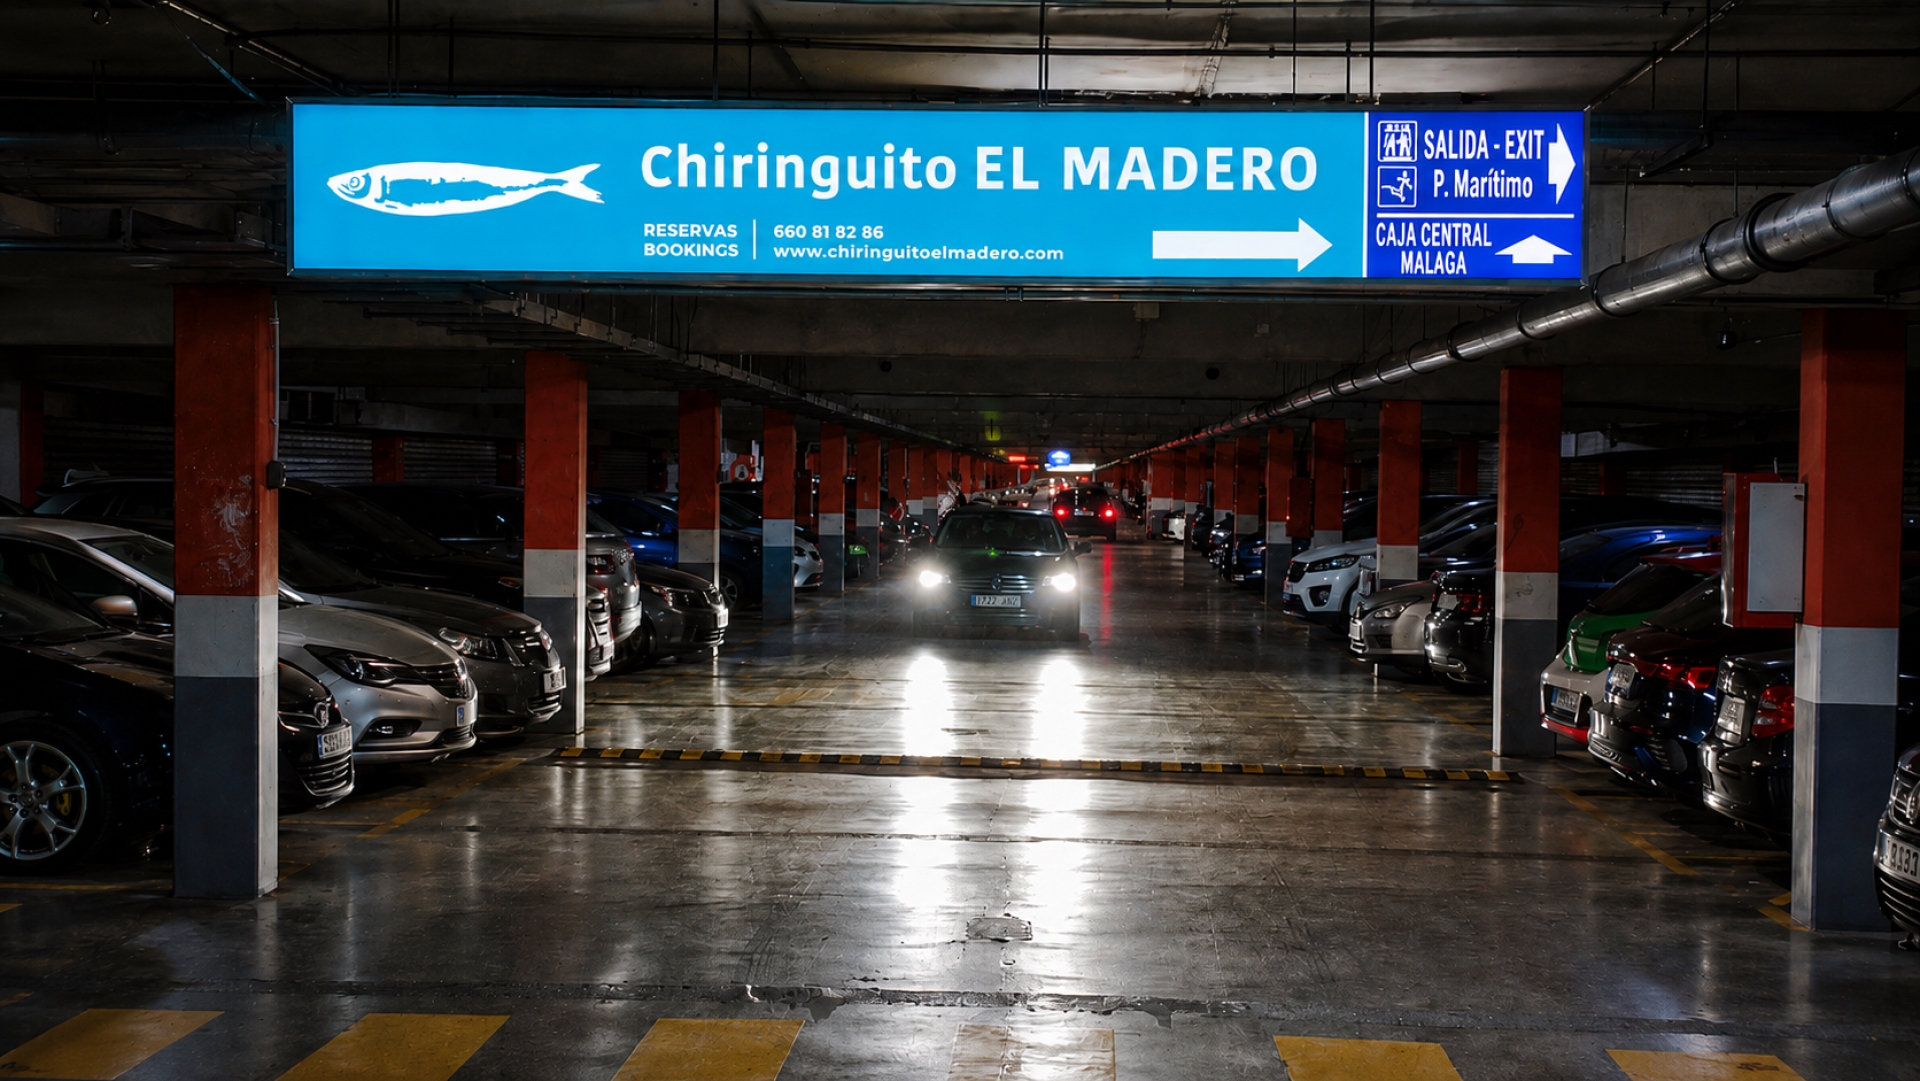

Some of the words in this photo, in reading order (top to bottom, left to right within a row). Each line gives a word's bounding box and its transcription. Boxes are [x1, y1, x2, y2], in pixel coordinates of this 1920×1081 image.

[1423, 129, 1489, 160] SALIDA
[1505, 129, 1545, 160] EXIT
[641, 142, 957, 200] Chiringuito
[976, 146, 1039, 190] EL
[1063, 146, 1318, 191] MADERO
[1433, 168, 1449, 198] P.
[1454, 167, 1533, 198] Marítimo
[643, 223, 738, 238] RESERVAS
[773, 225, 807, 239] 660
[811, 225, 830, 239] 81
[835, 225, 857, 239] 82
[861, 225, 884, 239] 86
[1376, 222, 1417, 247] CAJA
[1420, 222, 1493, 247] CENTRAL
[643, 243, 739, 257] BOOKINGS
[773, 244, 1064, 262] www.chiringuitoelmadero.com
[1400, 250, 1467, 275] MALAGA
